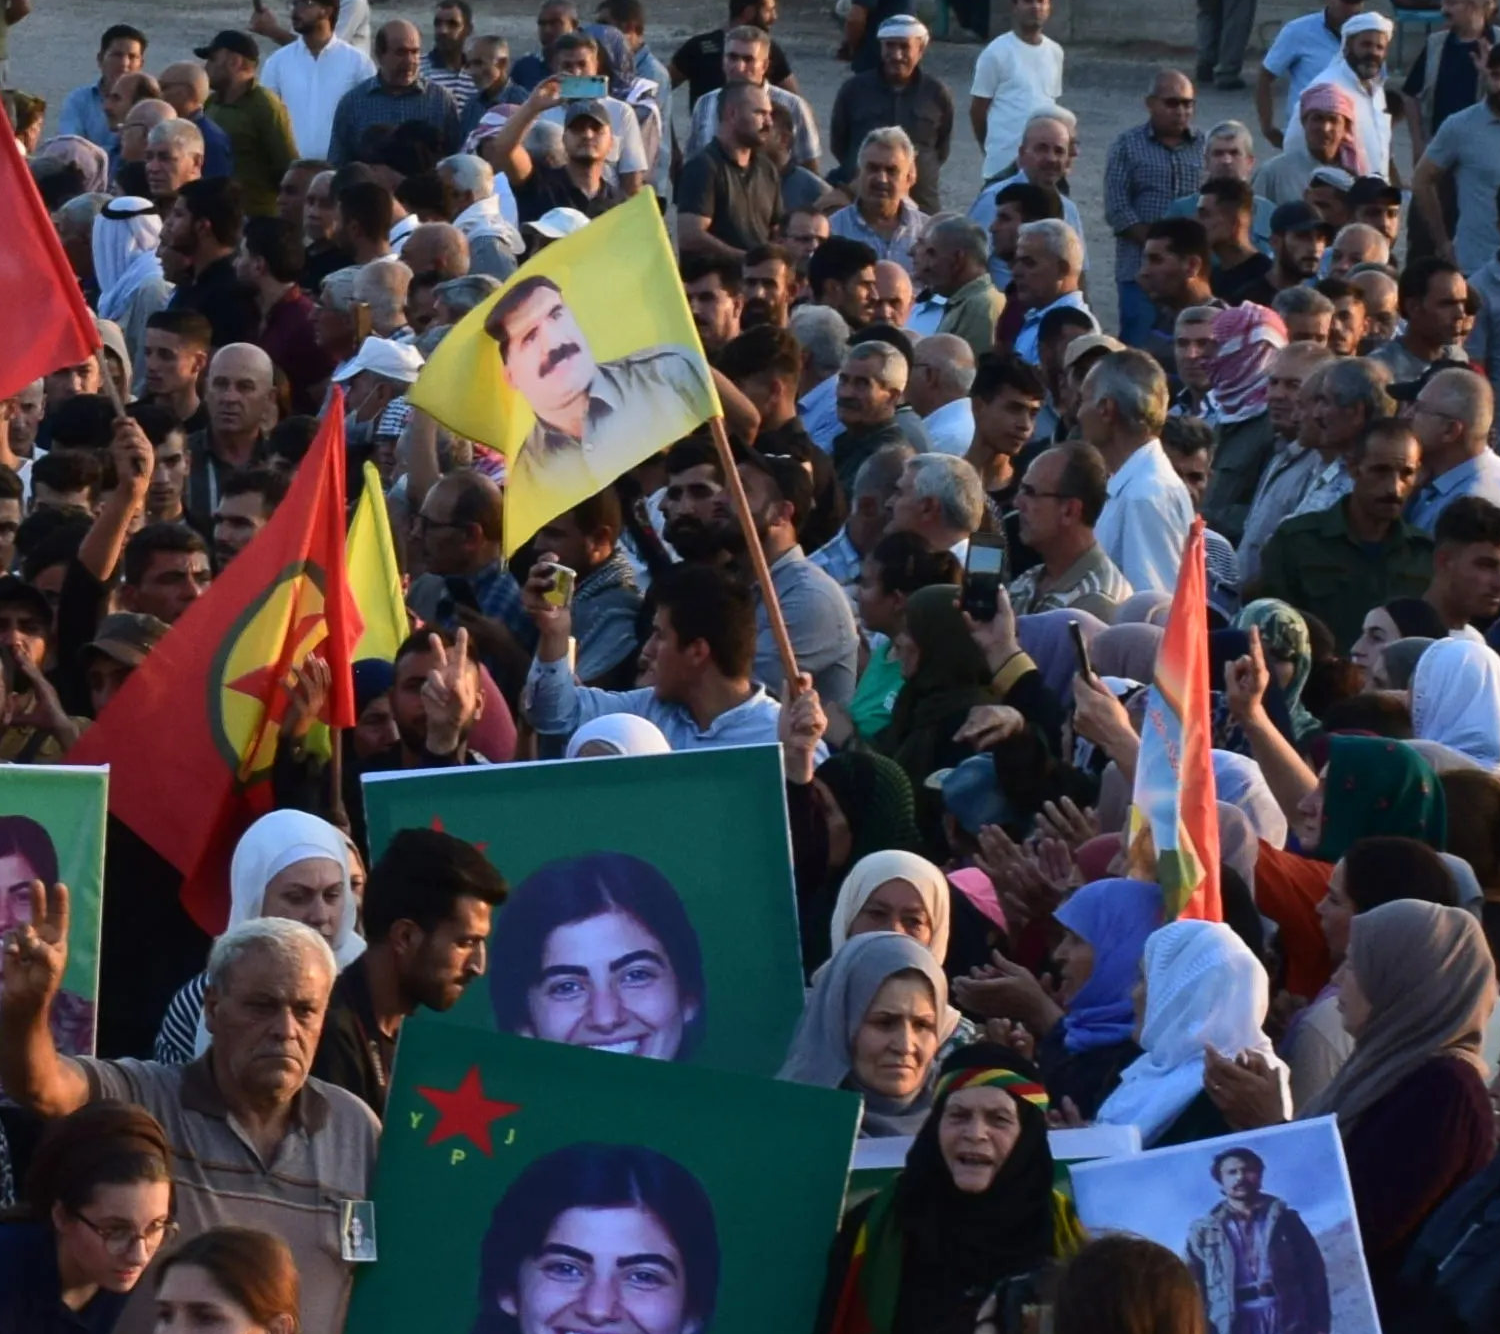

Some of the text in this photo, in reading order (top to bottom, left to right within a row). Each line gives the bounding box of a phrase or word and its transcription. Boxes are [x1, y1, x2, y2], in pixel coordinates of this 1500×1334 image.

[409, 1110, 516, 1166] Y P J
